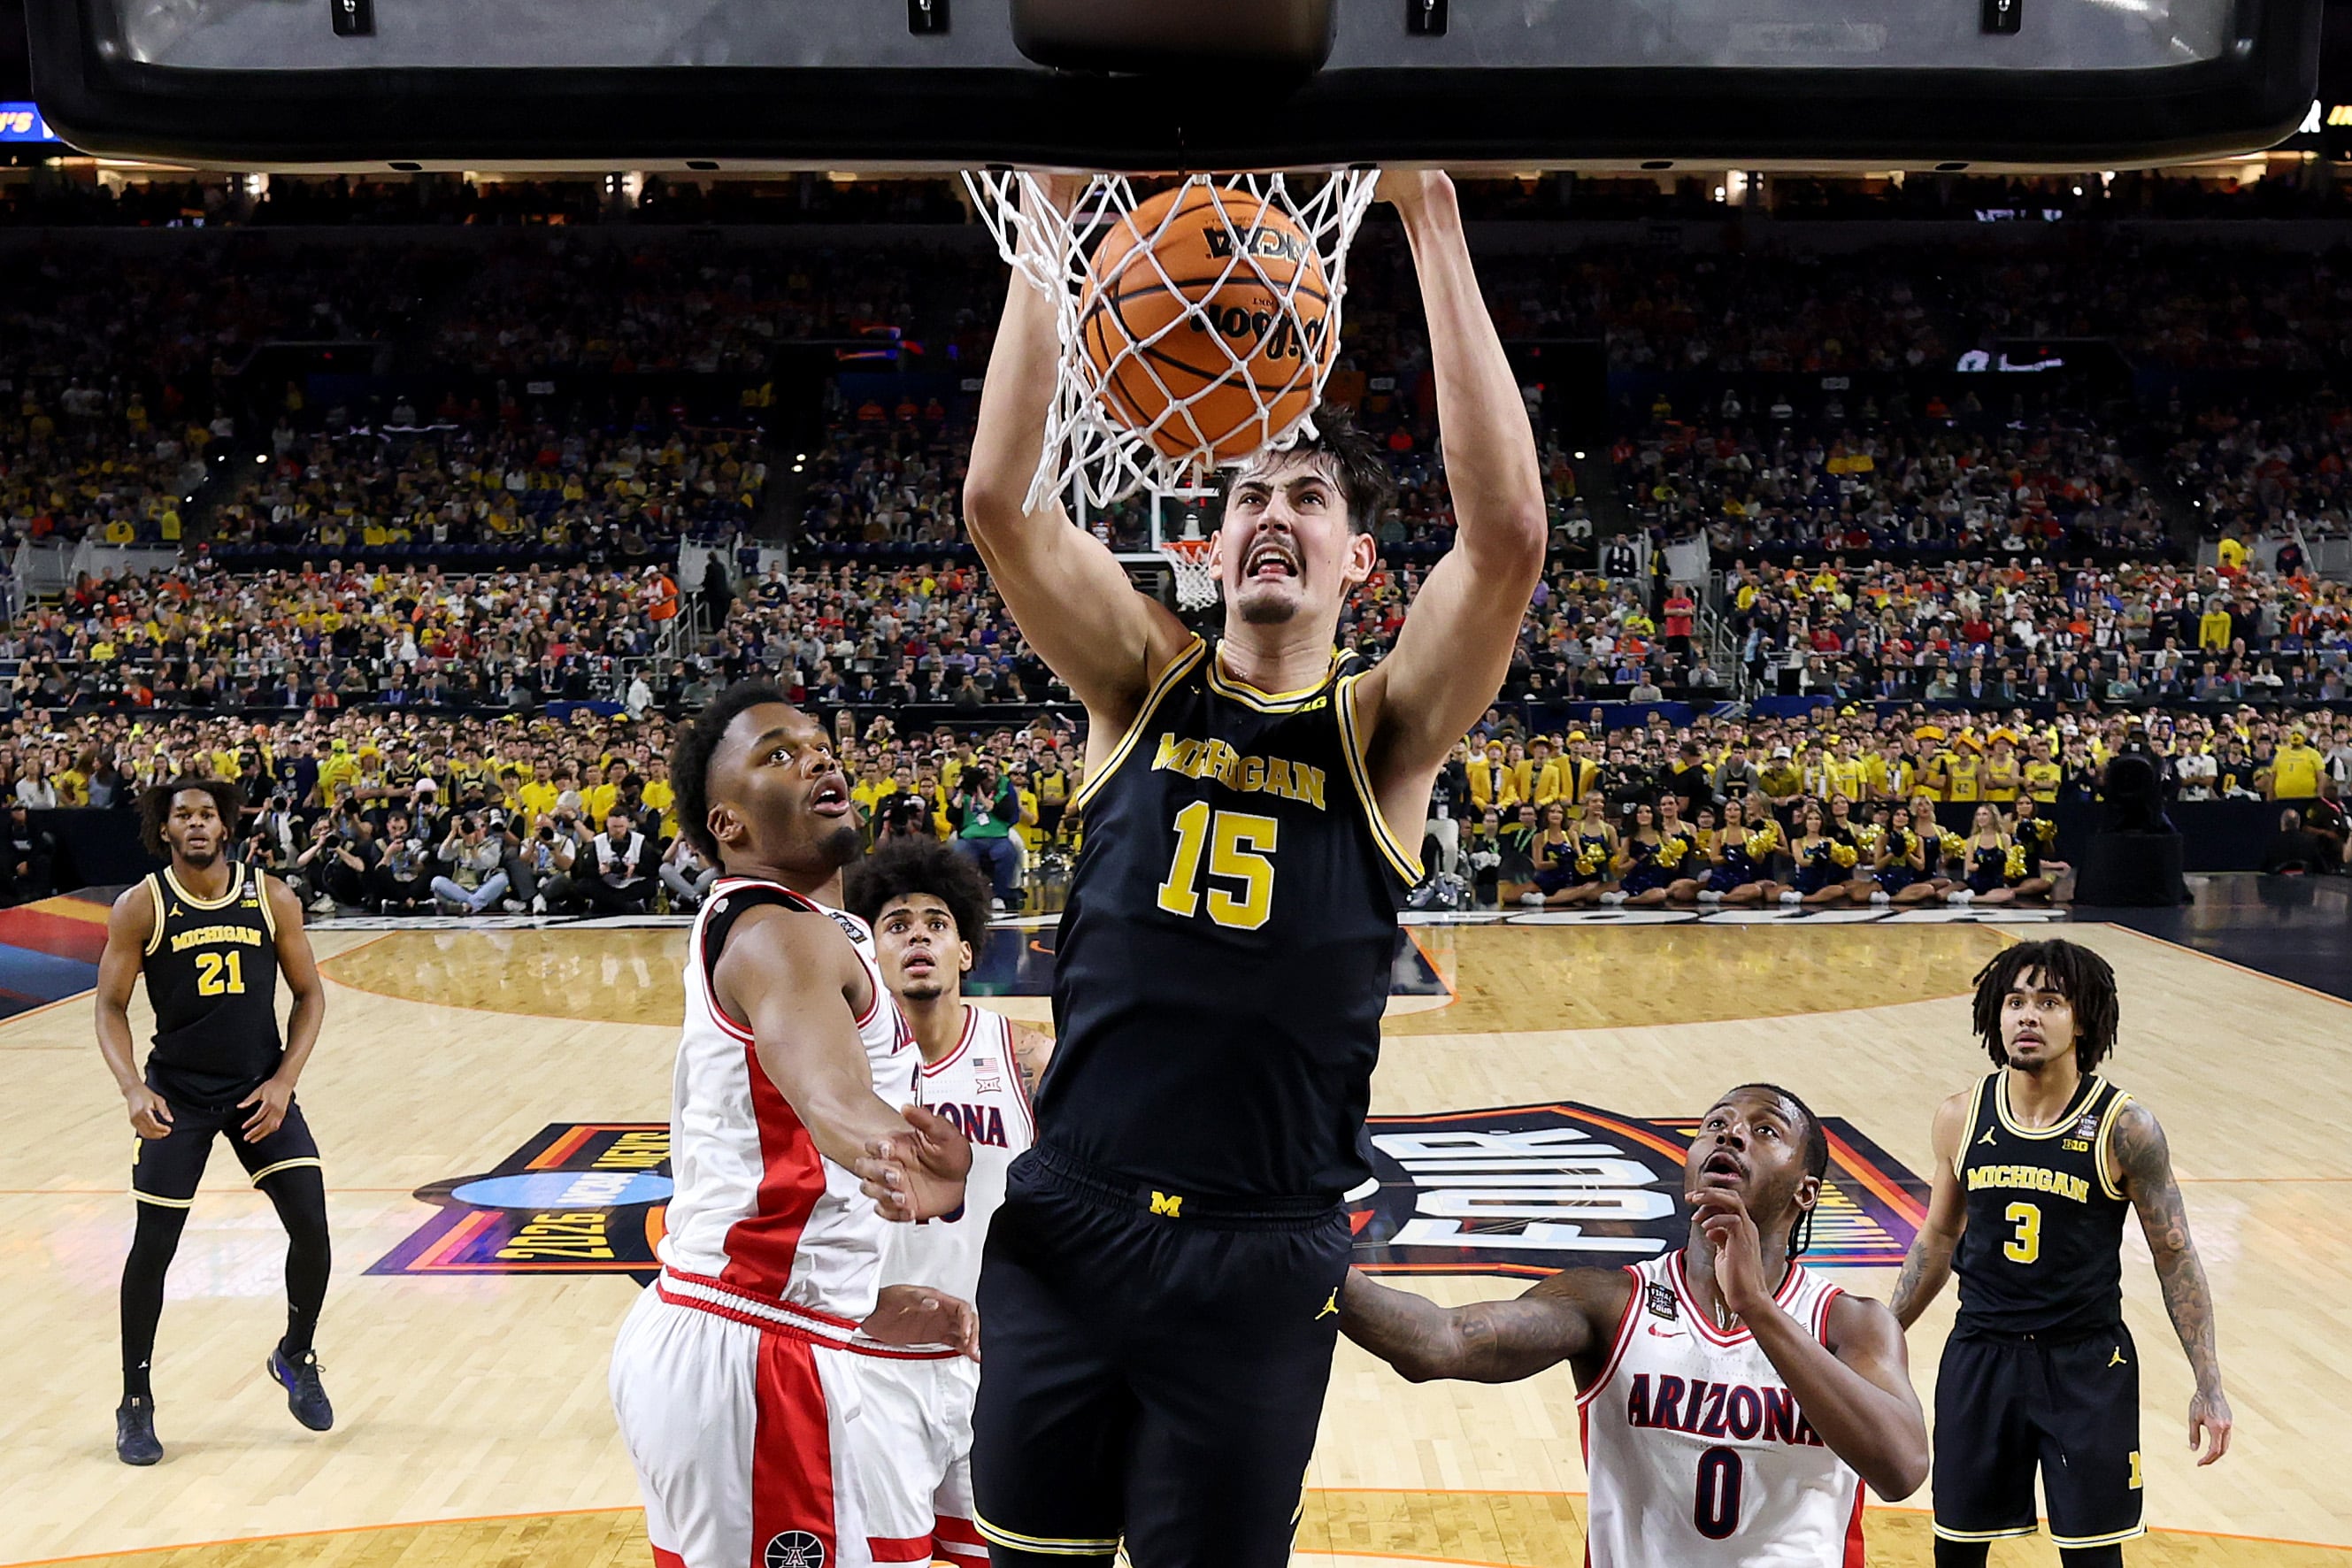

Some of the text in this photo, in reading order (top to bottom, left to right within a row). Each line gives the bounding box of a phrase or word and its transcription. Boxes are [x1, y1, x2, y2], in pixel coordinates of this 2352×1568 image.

[1151, 733, 1326, 811] MIHIGAN
[1157, 800, 1278, 930] 15
[171, 926, 262, 952] MICHIGAN
[196, 950, 245, 995] 21
[554, 1172, 639, 1203] NCAA
[1149, 1191, 1183, 1218] M
[1371, 1127, 1676, 1253] FOUR
[1967, 1165, 2089, 1203] MICHIGAN
[495, 1212, 615, 1258] 2026
[2003, 1202, 2041, 1264] 3
[1695, 1446, 1742, 1540] 0
[784, 1548, 806, 1566] A
